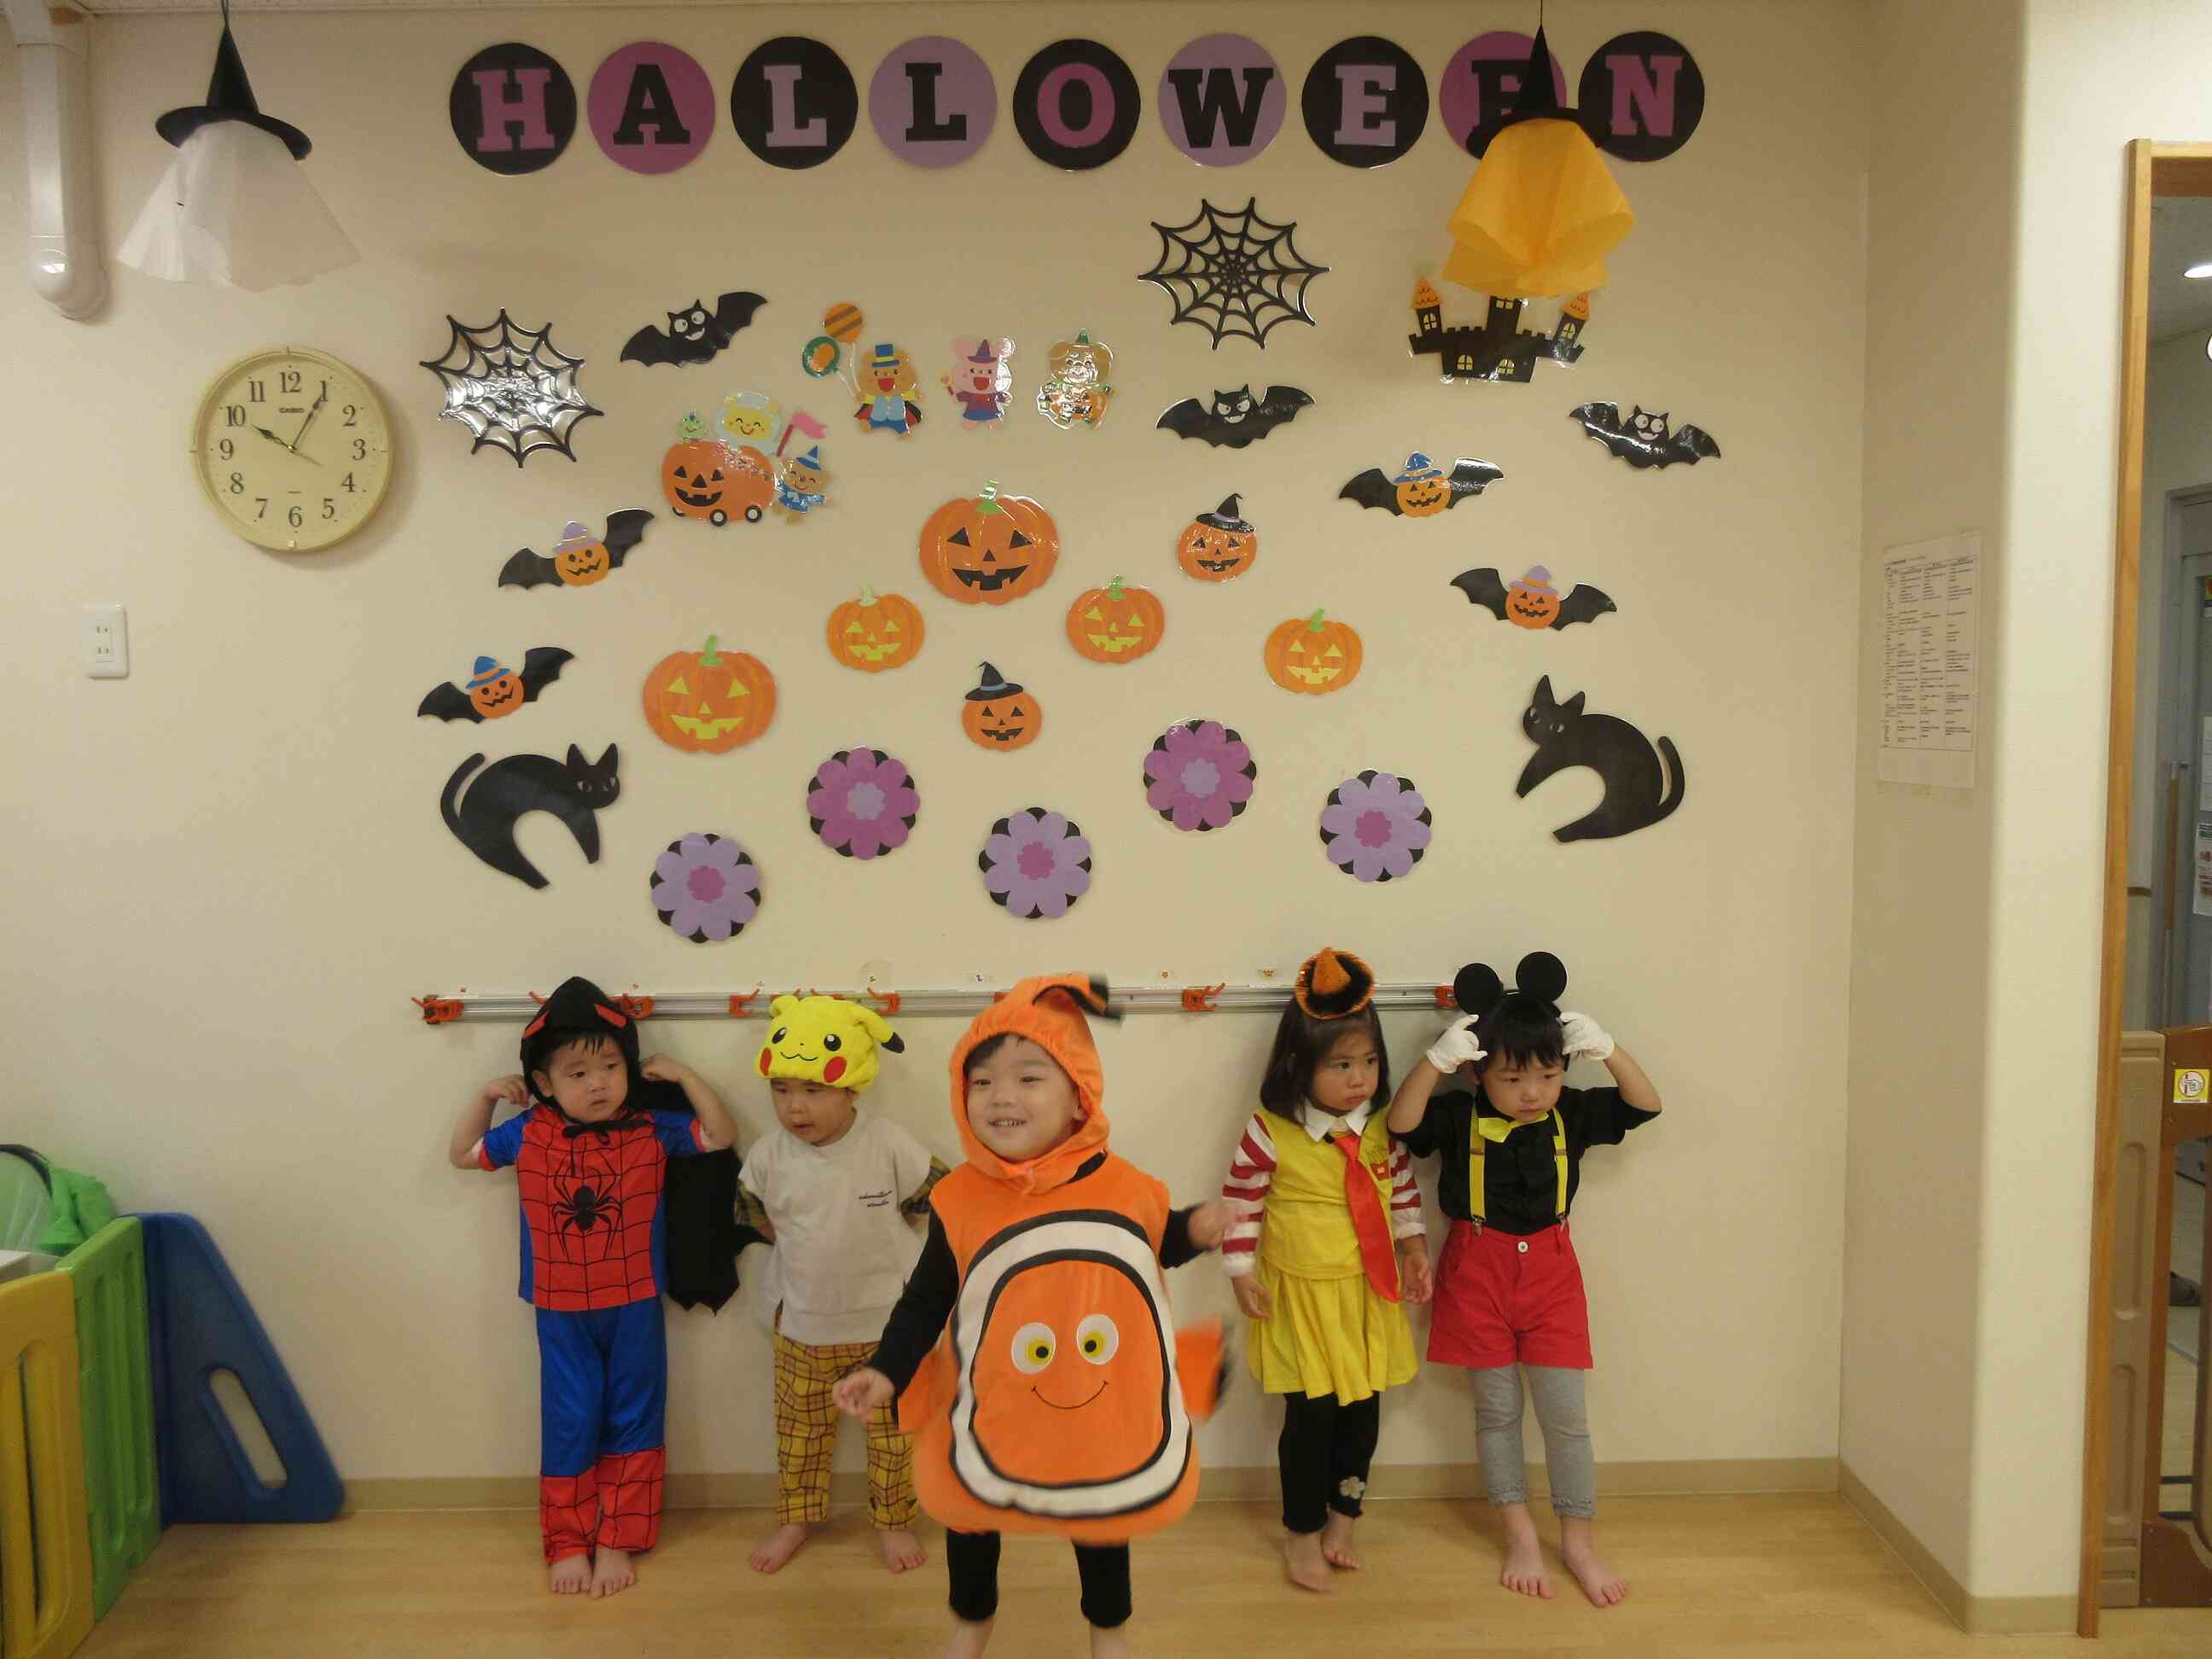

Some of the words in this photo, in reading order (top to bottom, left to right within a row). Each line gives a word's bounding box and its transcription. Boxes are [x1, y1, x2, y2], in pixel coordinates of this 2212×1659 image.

[248, 381, 266, 403] 11
[279, 371, 301, 393] 12
[320, 381, 329, 402] 1
[225, 405, 246, 427] 10
[342, 405, 356, 427] 2
[219, 439, 234, 461] 9
[352, 439, 366, 461] 3
[230, 472, 244, 494] 8
[341, 472, 356, 492] 4
[255, 498, 268, 518] 7
[288, 506, 302, 527] 6
[322, 498, 335, 519] 5
